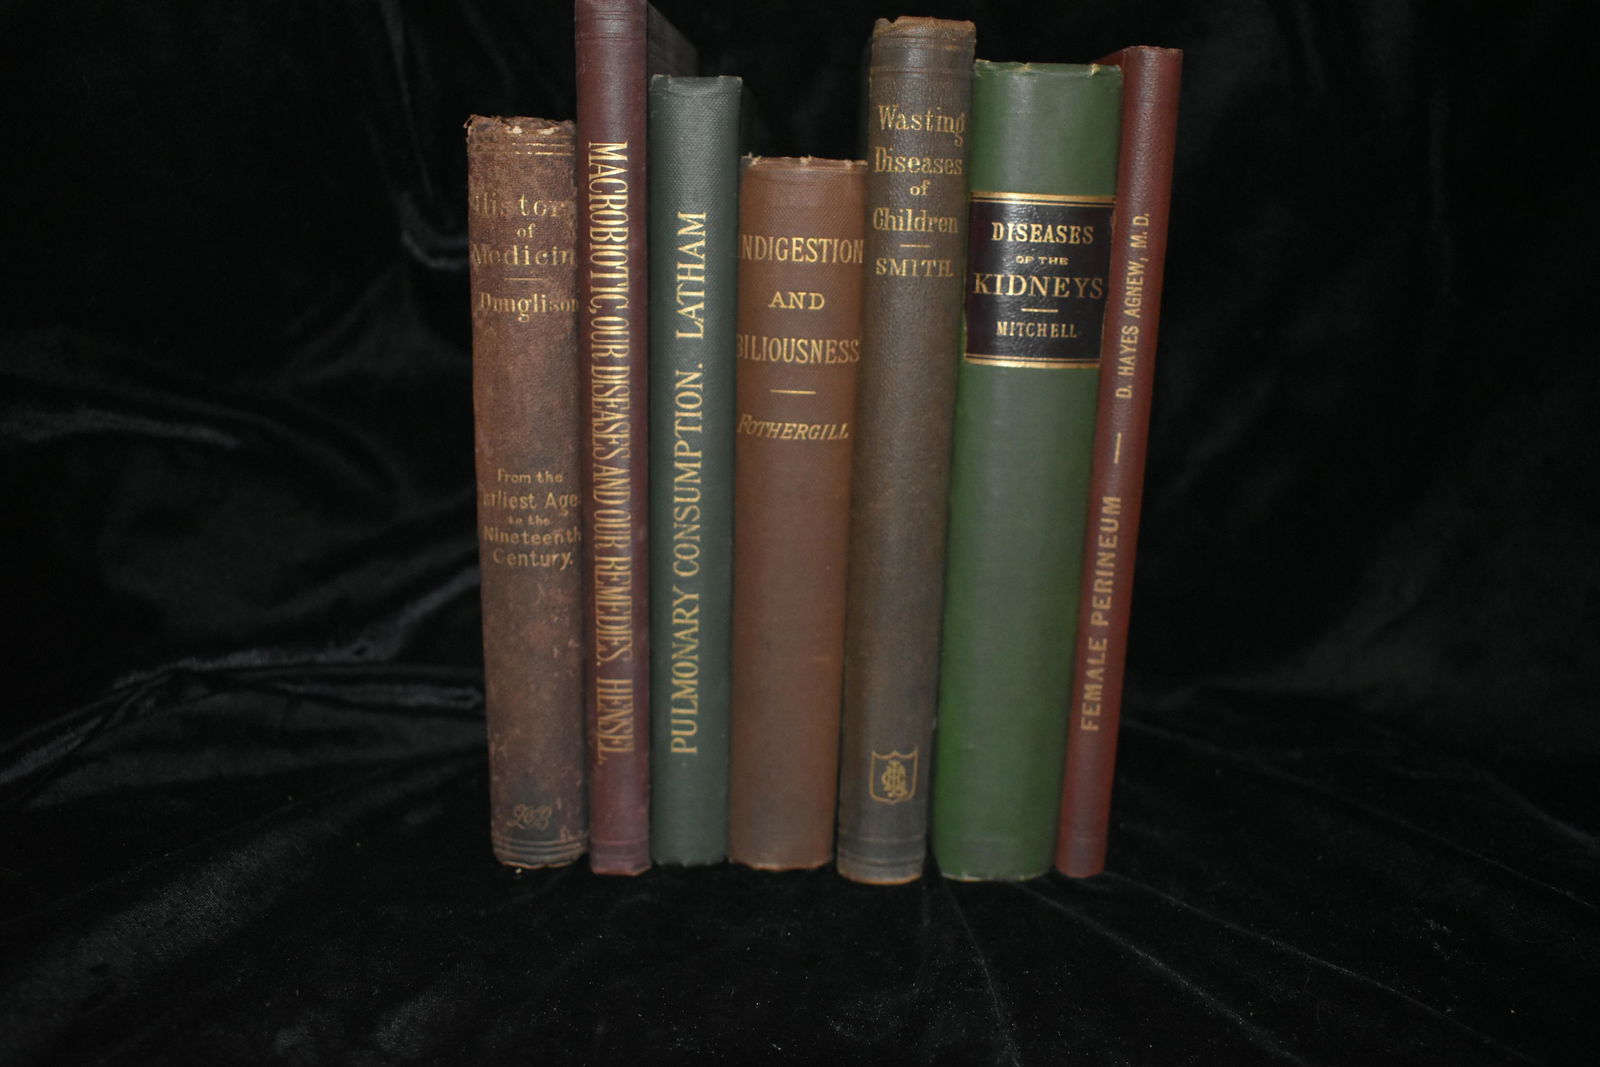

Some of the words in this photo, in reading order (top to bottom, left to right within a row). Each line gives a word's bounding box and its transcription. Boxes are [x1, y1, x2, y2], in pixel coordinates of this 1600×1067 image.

[877, 104, 965, 147] Wasting
[874, 146, 964, 175] Diseases
[910, 180, 931, 196] of
[516, 222, 536, 238] of
[588, 141, 630, 314] MACROBIOTIC,
[873, 207, 959, 233] Children
[991, 222, 1095, 245] DISEASES
[739, 234, 865, 264] NDIGESTION
[1016, 255, 1033, 265] OF
[1039, 256, 1069, 266] THE
[675, 211, 707, 339] LATHAM
[876, 257, 955, 278] SMITH
[768, 291, 826, 310] AND
[973, 273, 1104, 299] KIDNEYS
[1123, 256, 1149, 319] AGNEW,
[480, 292, 580, 323] Dunglison
[590, 316, 630, 360] OUR
[996, 321, 1078, 339] MITCHELL
[1117, 325, 1140, 377] HAYES
[1115, 384, 1133, 400] D.
[591, 365, 631, 460] DISEASES
[737, 413, 849, 440] FOTHERGILL
[497, 468, 532, 483] From
[536, 470, 565, 484] the
[593, 462, 631, 505] AND
[672, 362, 704, 577] CONSUMPTION.
[483, 525, 582, 545] Nineteenth
[507, 515, 524, 525] to
[528, 515, 552, 526] the
[594, 508, 631, 549] OUR
[493, 547, 574, 571] Century.
[1091, 496, 1122, 627] PERINEUM
[594, 556, 632, 667] REMEDIES.
[670, 585, 701, 754] PULMONARY
[1081, 637, 1108, 732] FEMALE
